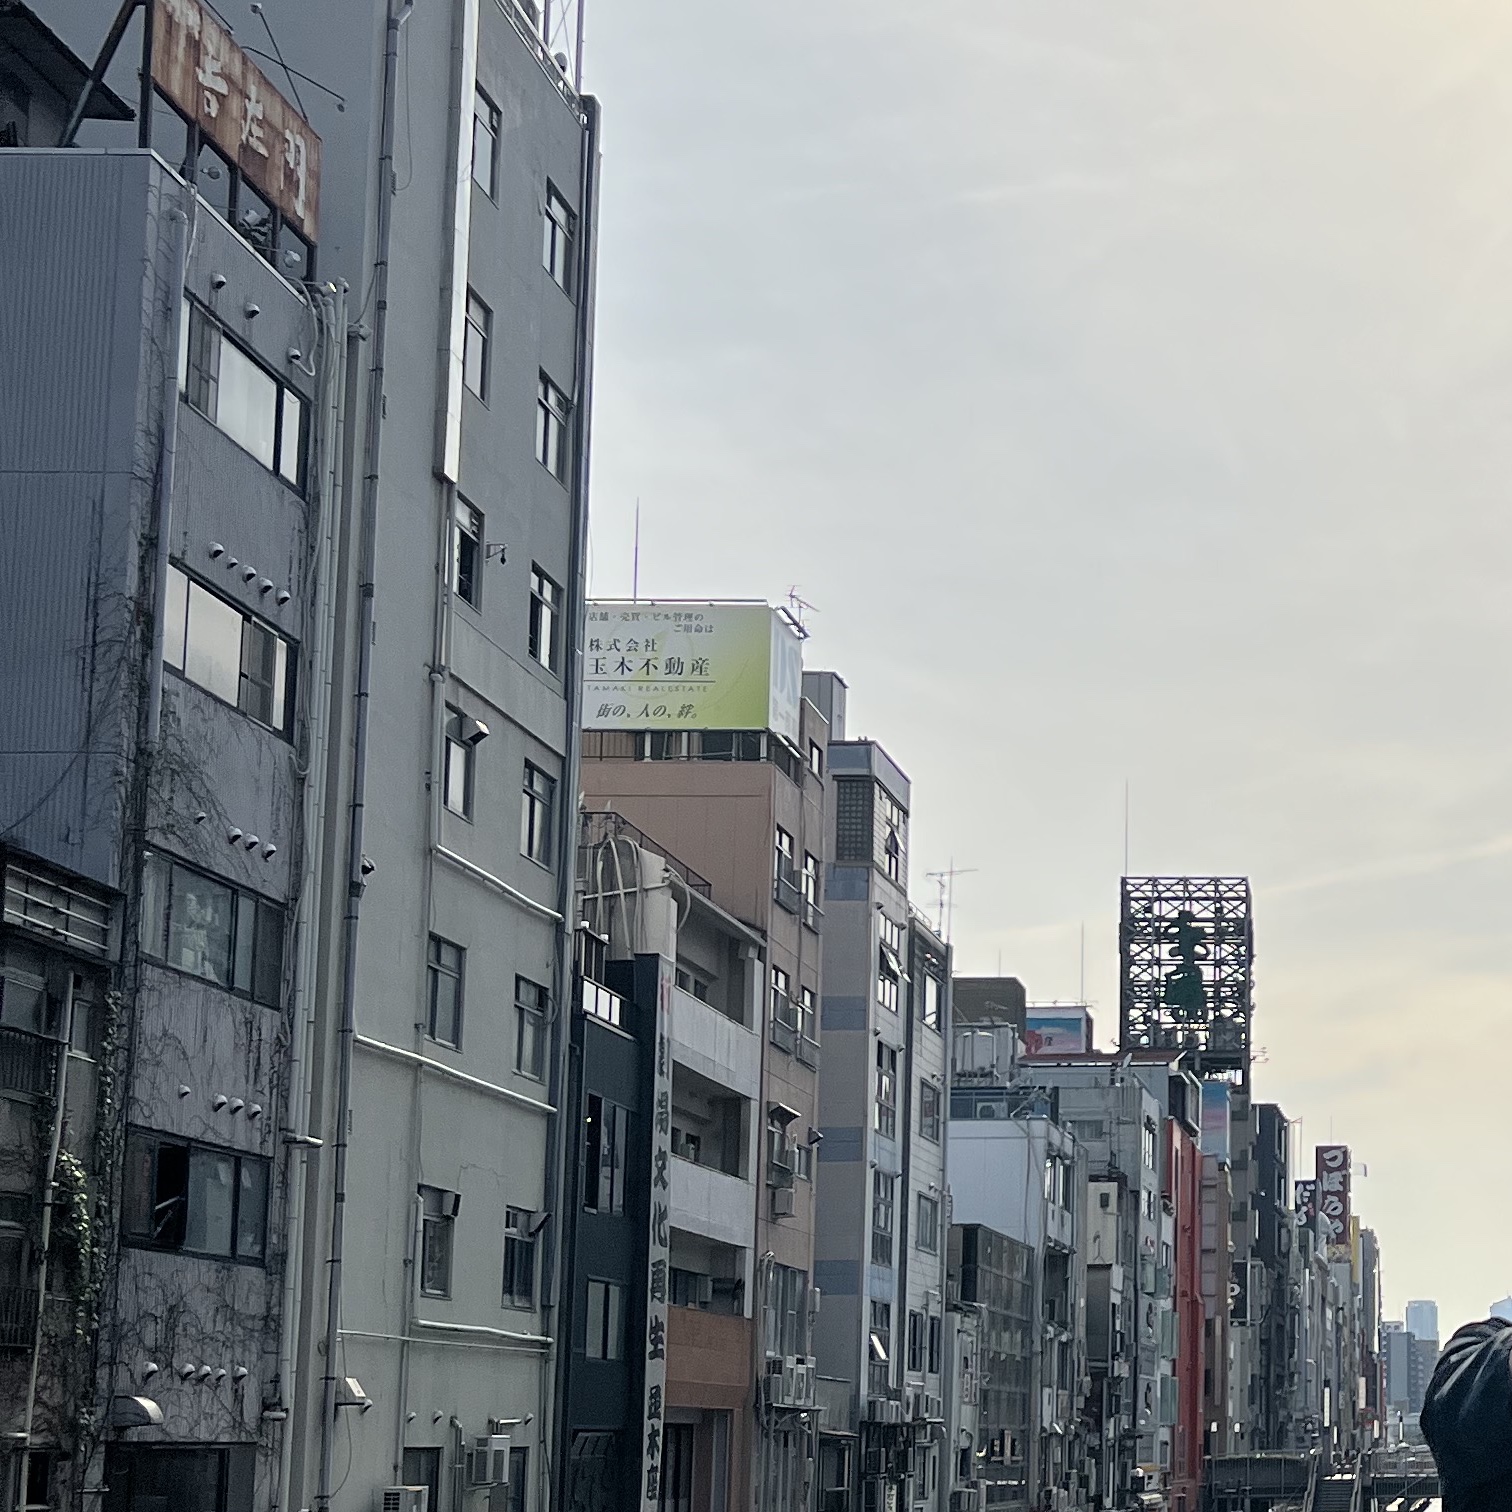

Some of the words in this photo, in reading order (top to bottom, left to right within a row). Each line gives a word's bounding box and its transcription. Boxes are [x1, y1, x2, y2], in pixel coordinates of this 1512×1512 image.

[588, 638, 658, 653] 株式会社
[589, 656, 710, 677] 玉木不動産
[587, 684, 632, 692] TAMAKI
